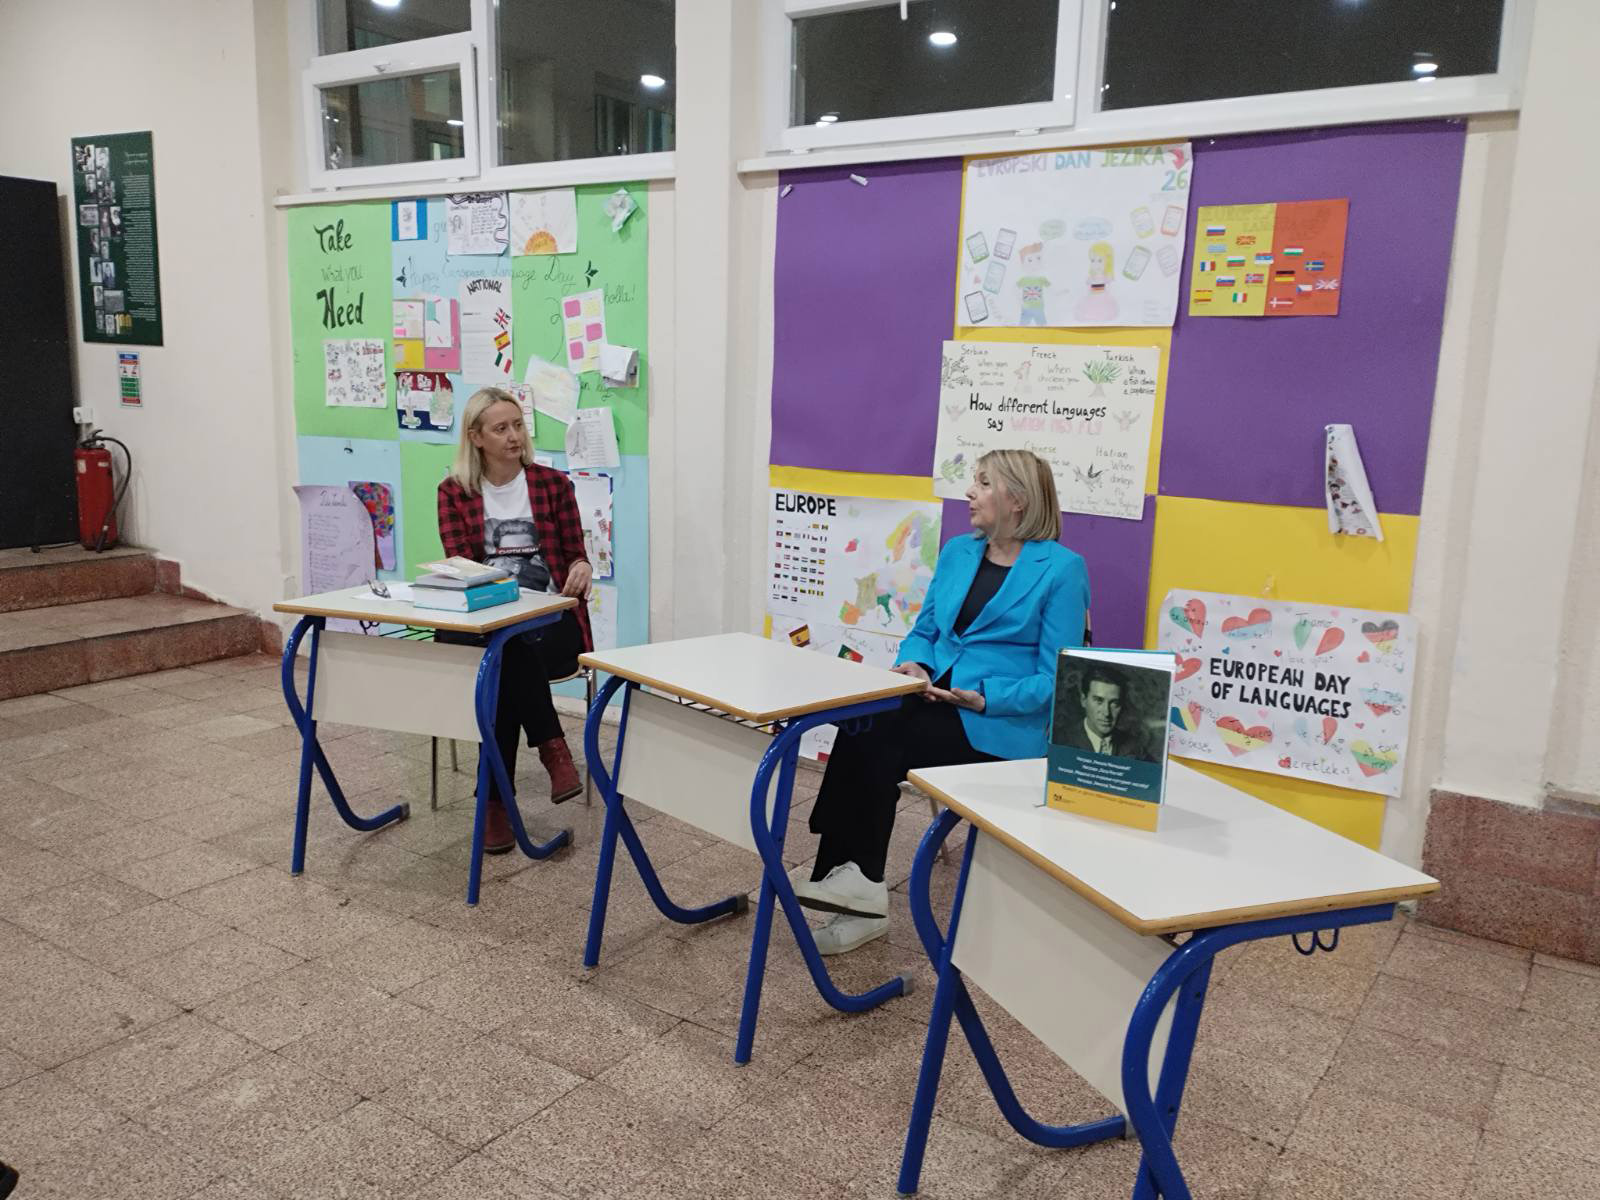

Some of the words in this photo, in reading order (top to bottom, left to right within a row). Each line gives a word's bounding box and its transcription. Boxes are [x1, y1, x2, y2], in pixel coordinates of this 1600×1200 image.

[1055, 152, 1091, 170] DAN
[313, 218, 353, 255] Take
[466, 279, 502, 295] NATIONAL
[316, 287, 364, 329] Need
[1103, 350, 1135, 361] Turkish
[969, 393, 992, 411] How
[998, 395, 1048, 414] different
[1052, 400, 1106, 421] languages
[987, 418, 1004, 432] say
[1096, 446, 1129, 458] Italian
[776, 493, 836, 516] EUROPE
[1210, 657, 1304, 687] EUROPEAN
[1315, 672, 1352, 694] DAY
[1211, 681, 1234, 700] OF
[1239, 685, 1352, 718] LANGUAGES
